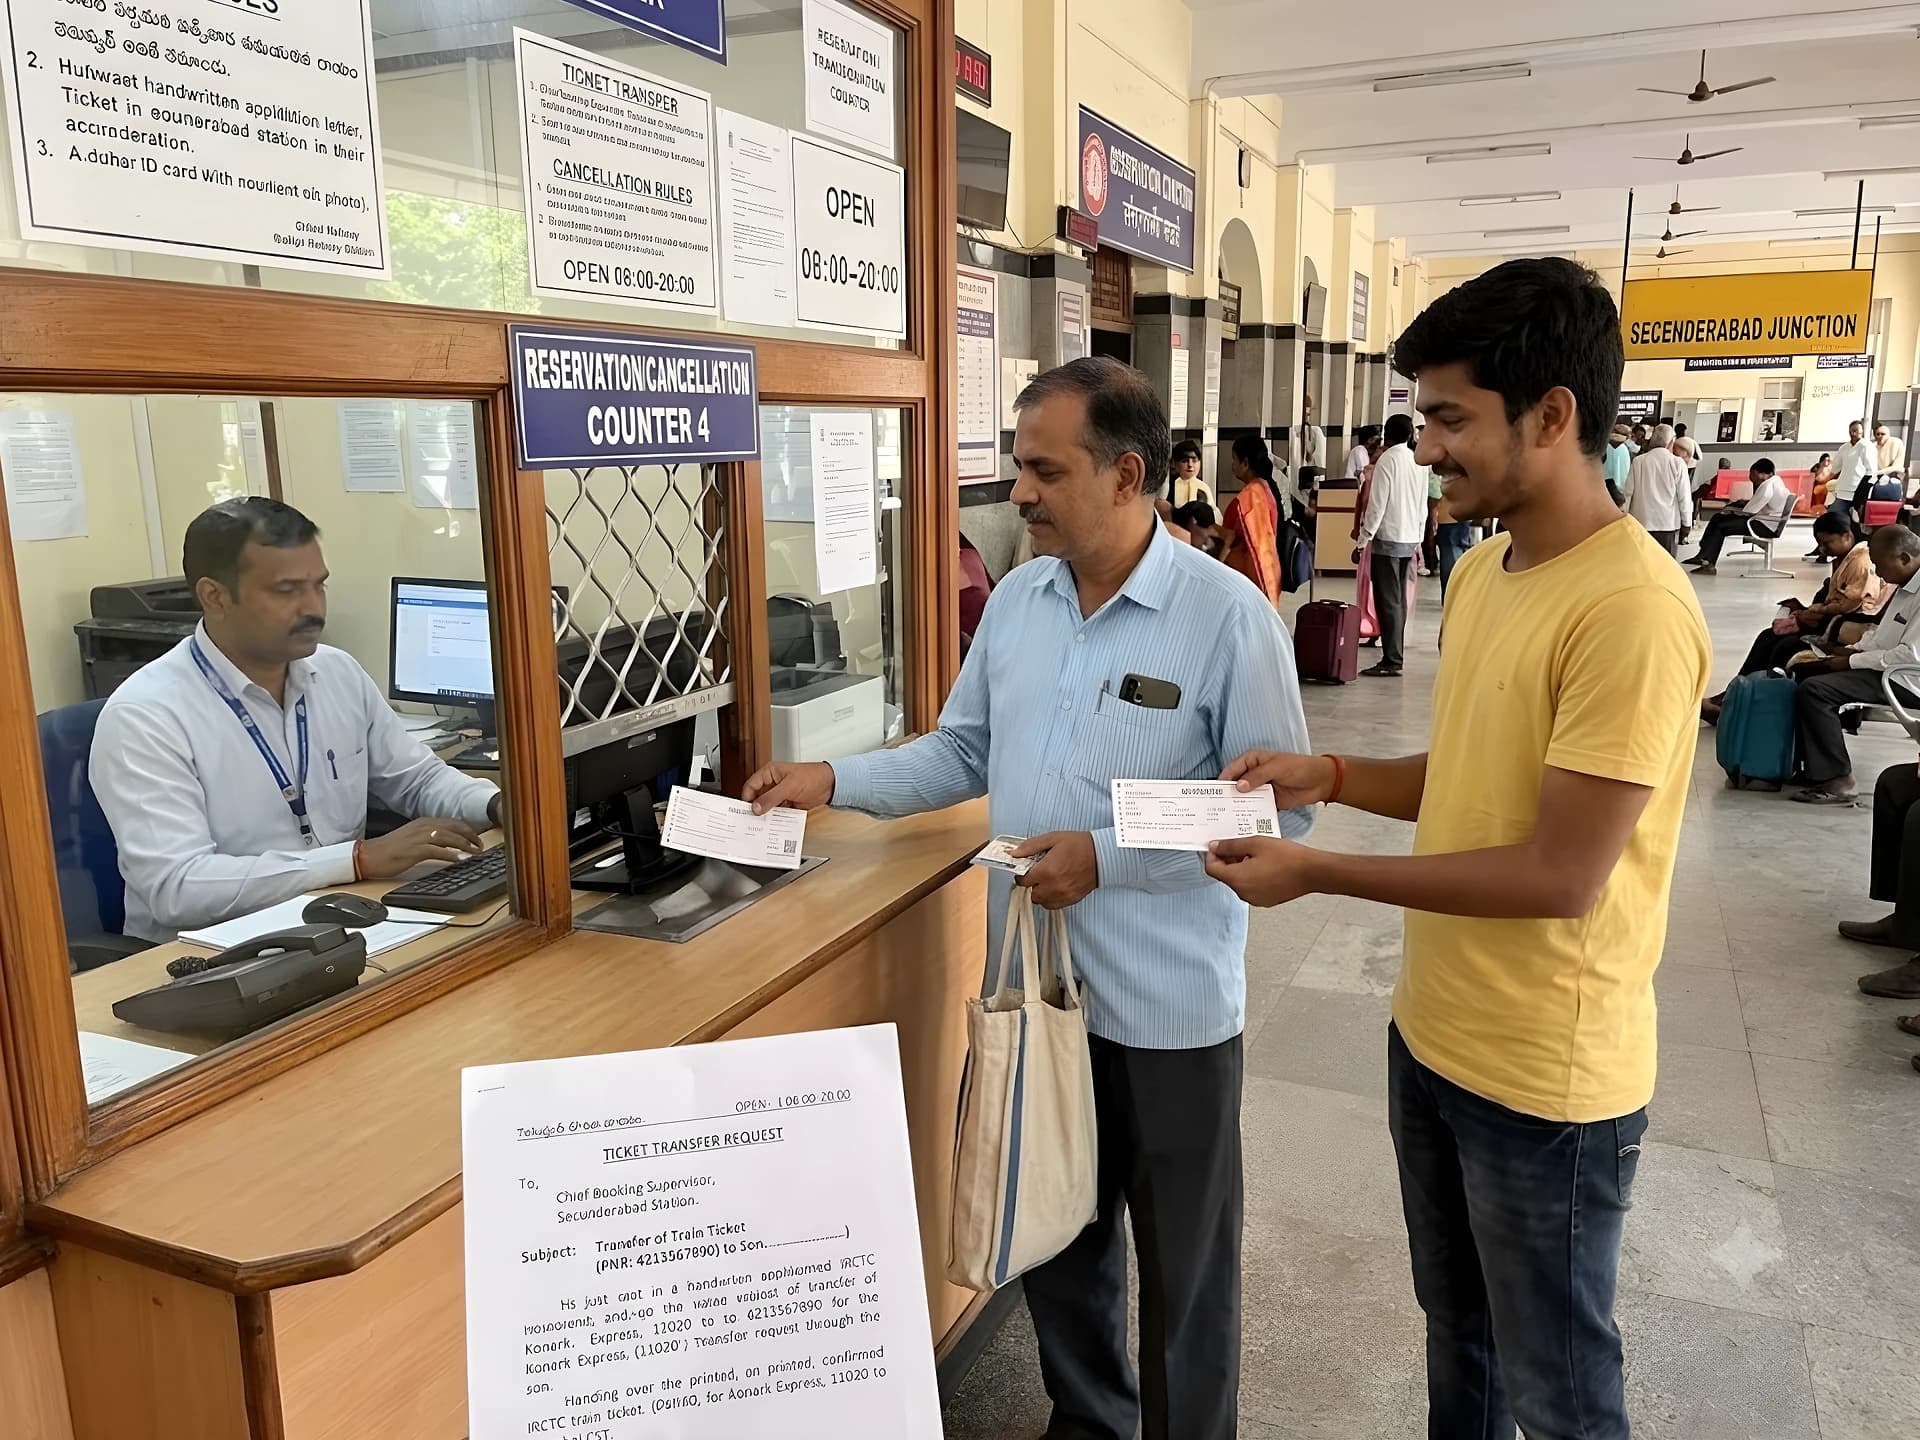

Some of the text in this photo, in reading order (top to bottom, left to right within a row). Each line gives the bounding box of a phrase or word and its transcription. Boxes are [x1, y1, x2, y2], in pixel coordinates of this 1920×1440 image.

[27, 51, 43, 69] 2.
[61, 86, 118, 112] Ticket
[126, 98, 141, 116] in
[37, 139, 53, 157] 3.
[163, 165, 197, 179] card
[553, 158, 693, 204] CANCELLATION RULES
[827, 187, 874, 227] OPEN
[564, 259, 610, 284] OPEN
[802, 248, 898, 294] 08:00-20:00
[1630, 313, 1857, 344] SECENDERABAD JUNCTION
[588, 406, 710, 445] COUNTER 4
[603, 1128, 783, 1160] TICKET TRANSFER REQUEST
[519, 1178, 538, 1189] To,
[654, 1231, 667, 1244] of
[596, 1257, 633, 1274] (PNR:
[724, 1243, 736, 1254] to
[652, 1286, 663, 1298] in
[746, 1368, 759, 1378] on
[831, 1368, 868, 1384] 11020
